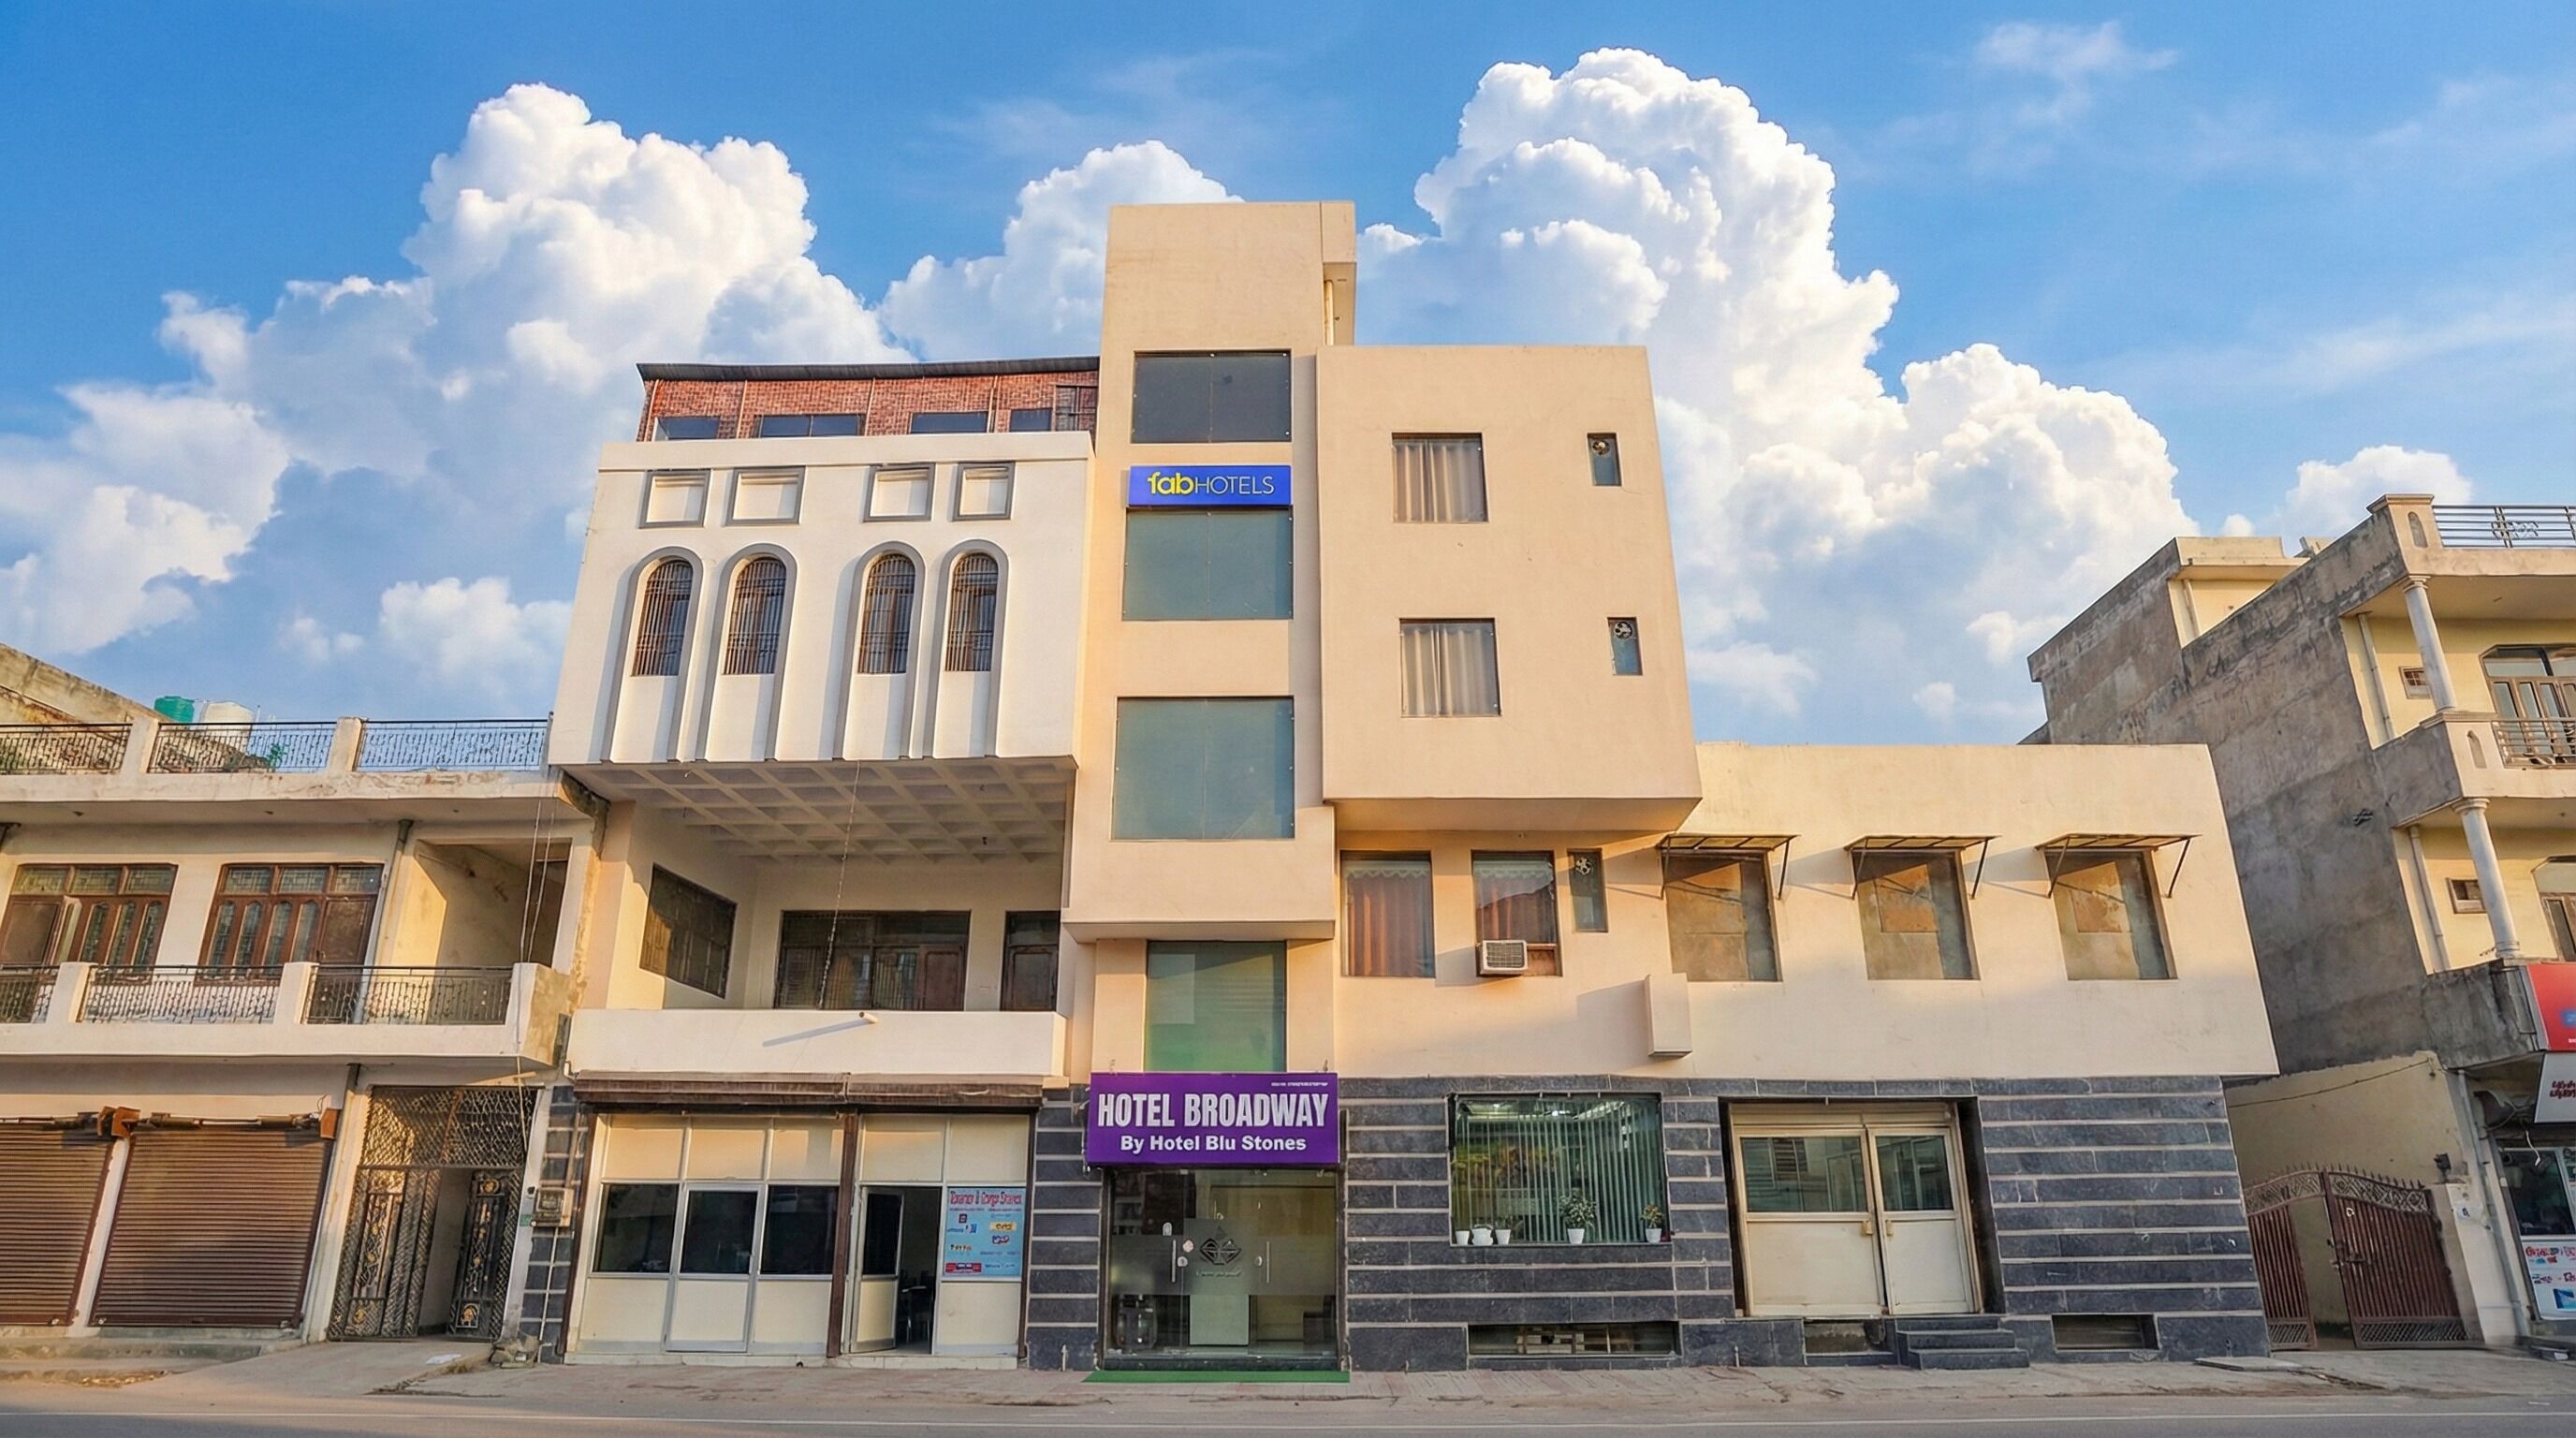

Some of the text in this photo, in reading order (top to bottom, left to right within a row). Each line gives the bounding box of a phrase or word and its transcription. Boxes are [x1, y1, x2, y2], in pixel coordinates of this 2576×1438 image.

[1097, 1093, 1328, 1127] HOTEL BROADWAY
[1120, 1134, 1307, 1154] By Hotel Blu Stones
